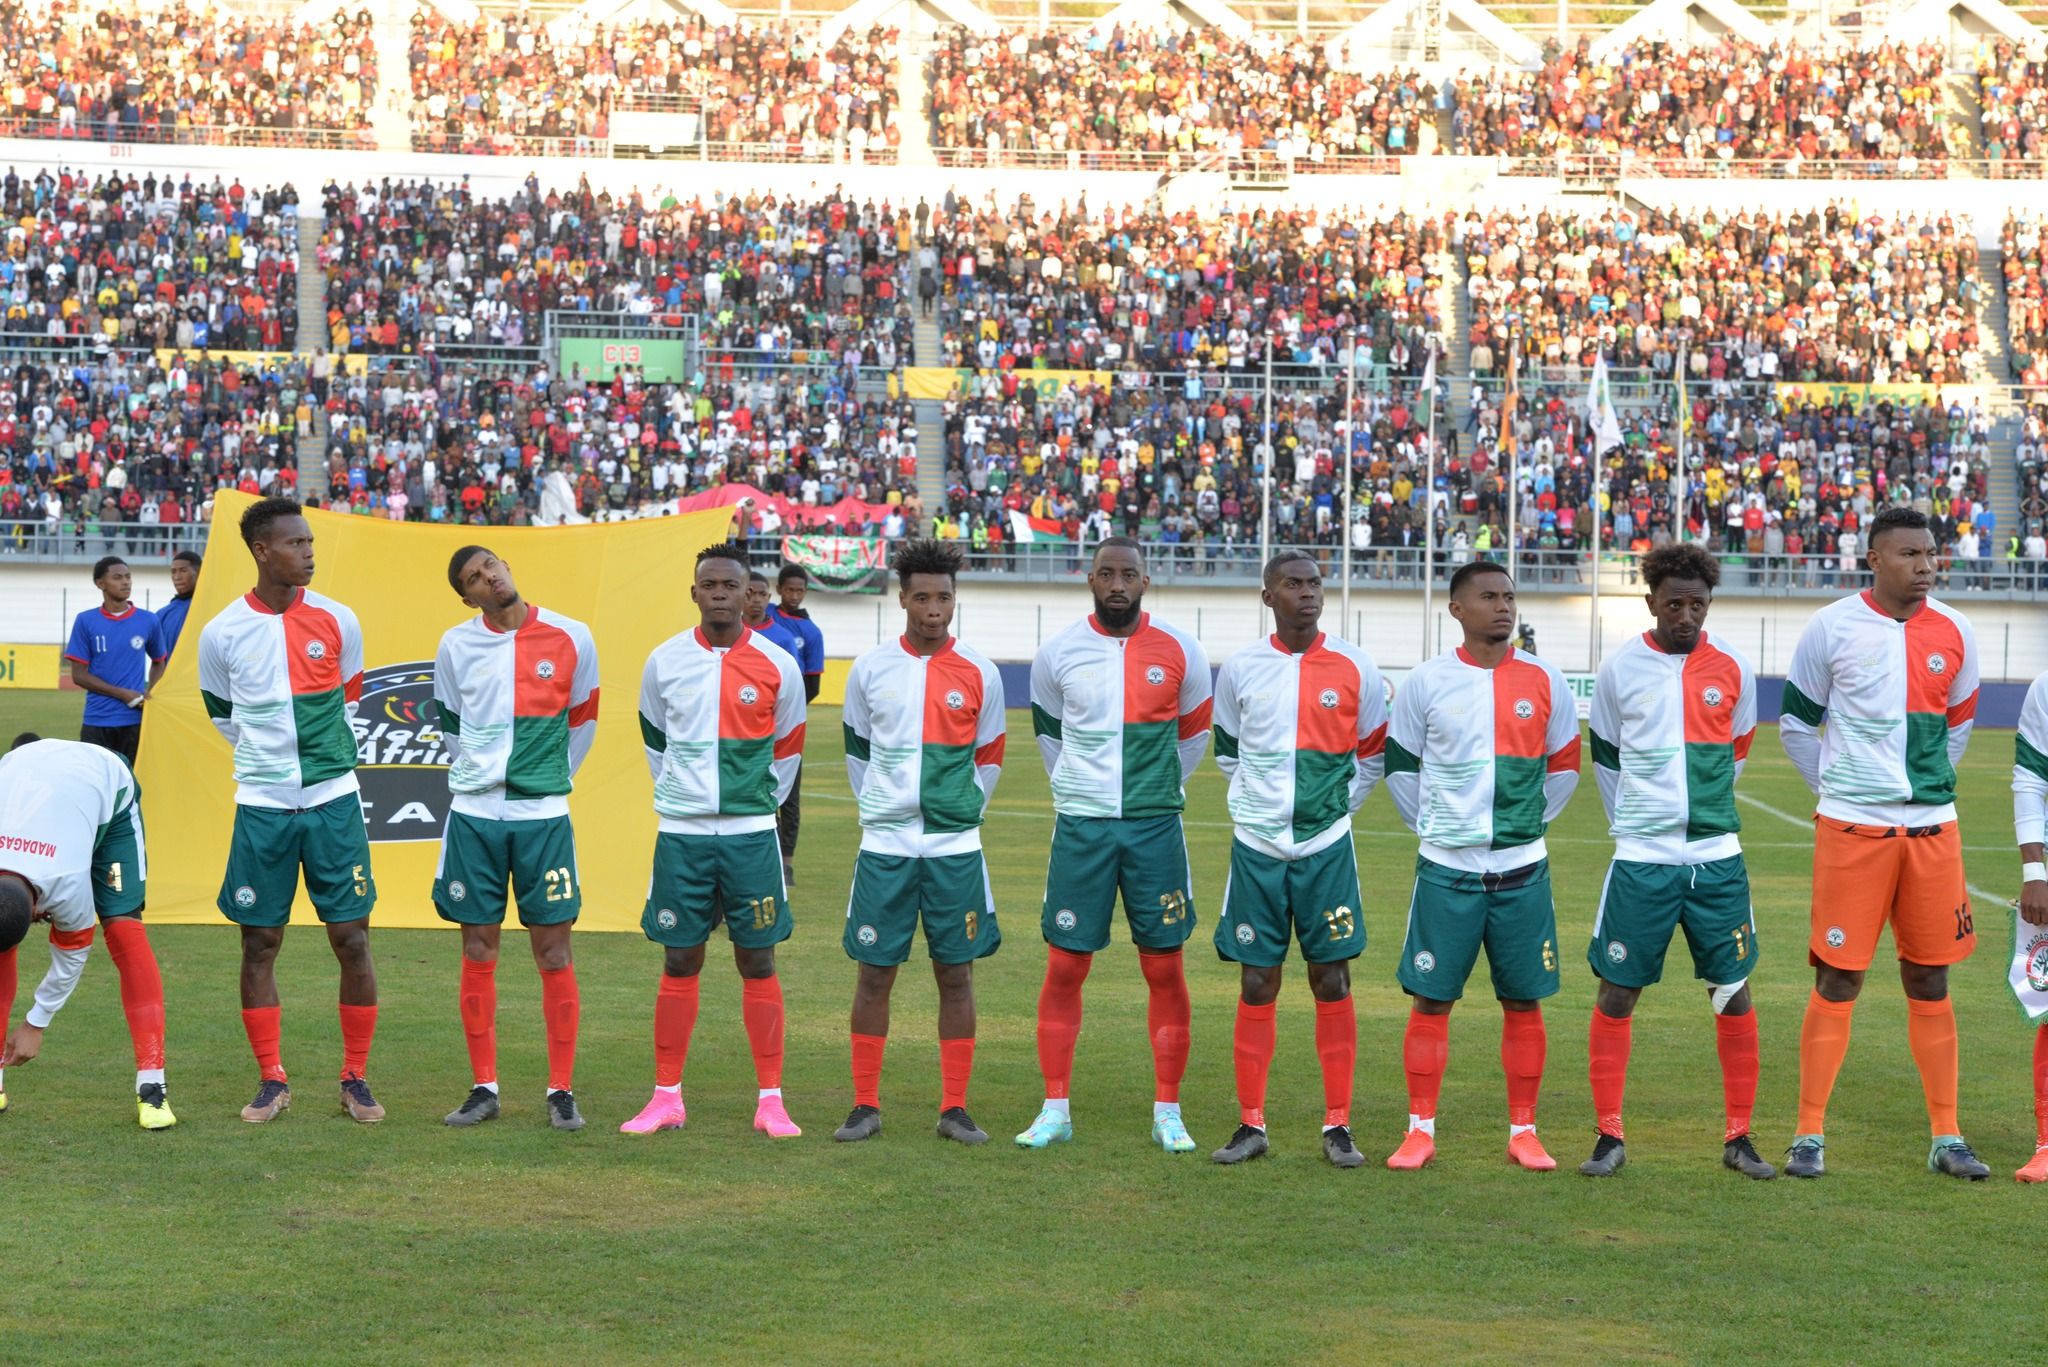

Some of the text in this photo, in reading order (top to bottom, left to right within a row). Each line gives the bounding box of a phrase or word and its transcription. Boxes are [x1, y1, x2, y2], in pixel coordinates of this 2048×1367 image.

[603, 344, 641, 363] C13
[96, 636, 107, 652] 11
[353, 865, 368, 896] 5
[545, 867, 573, 901] 21
[1160, 889, 1185, 925] 20
[1323, 906, 1354, 940] 19
[1955, 903, 1973, 940] 16
[1543, 940, 1557, 971] 6
